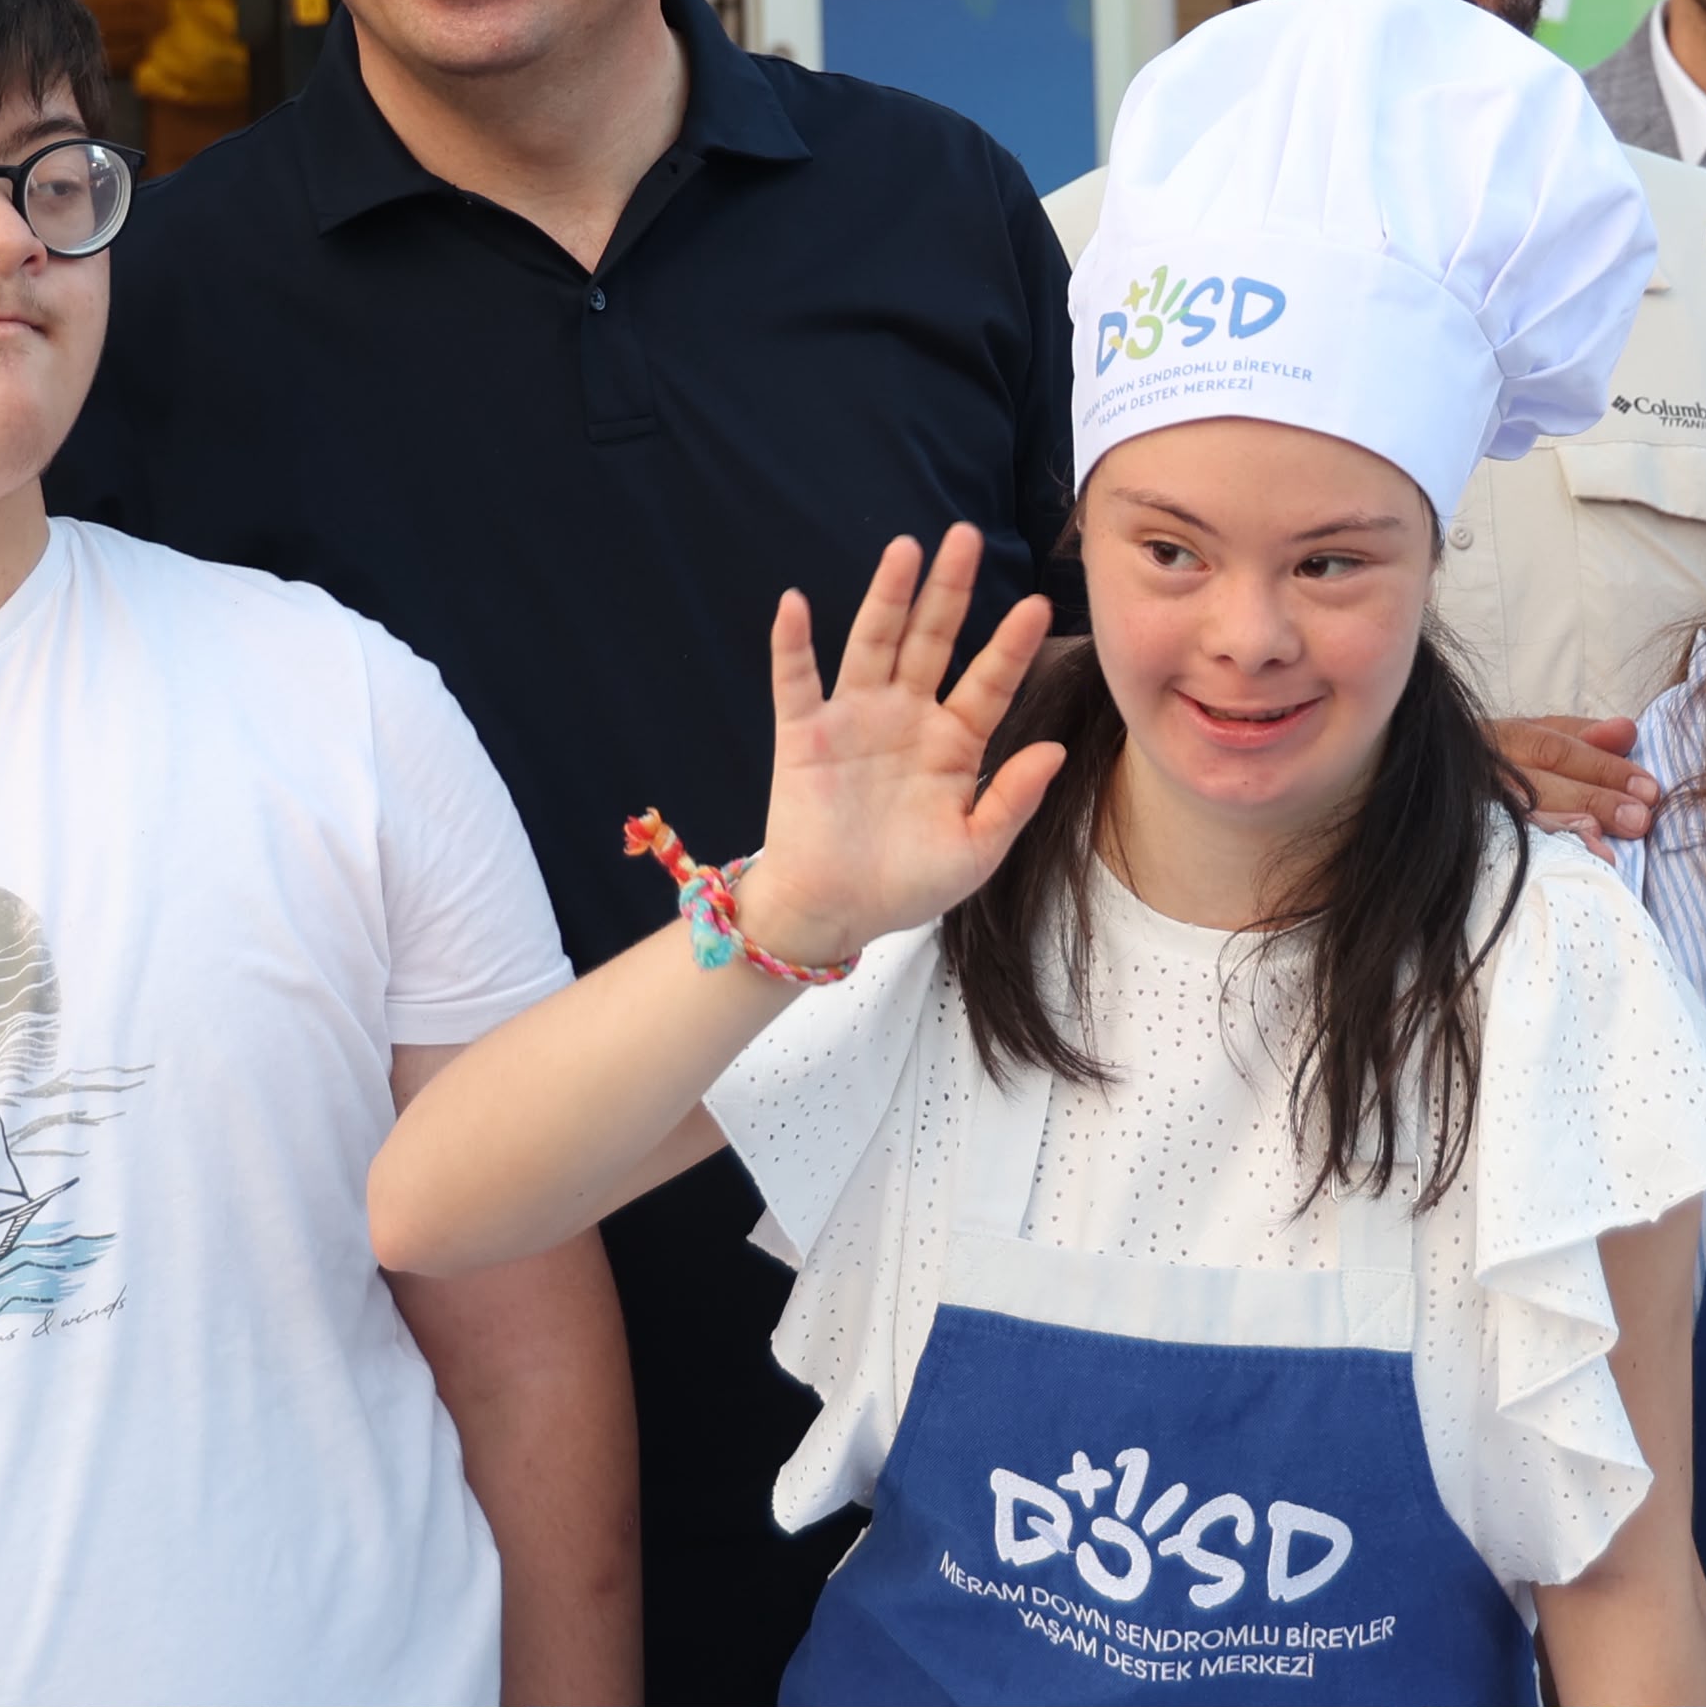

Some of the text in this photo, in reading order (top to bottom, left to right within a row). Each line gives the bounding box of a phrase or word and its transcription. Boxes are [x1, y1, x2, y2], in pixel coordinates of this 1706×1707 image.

[1101, 380, 1135, 406] DOWN
[1138, 359, 1228, 388] SENDROMLU
[1233, 356, 1313, 382] BİREYLER
[1130, 386, 1179, 410] DESTEK
[1183, 375, 1254, 394] MERKEZİ
[31, 1307, 55, 1339] &
[61, 1283, 128, 1328] winds
[939, 1550, 1396, 1653] MERAM DOWN SENDROMLU BİREYLER
[1017, 1607, 1315, 1682] YAŞAM DESTEK MERKEZİ
